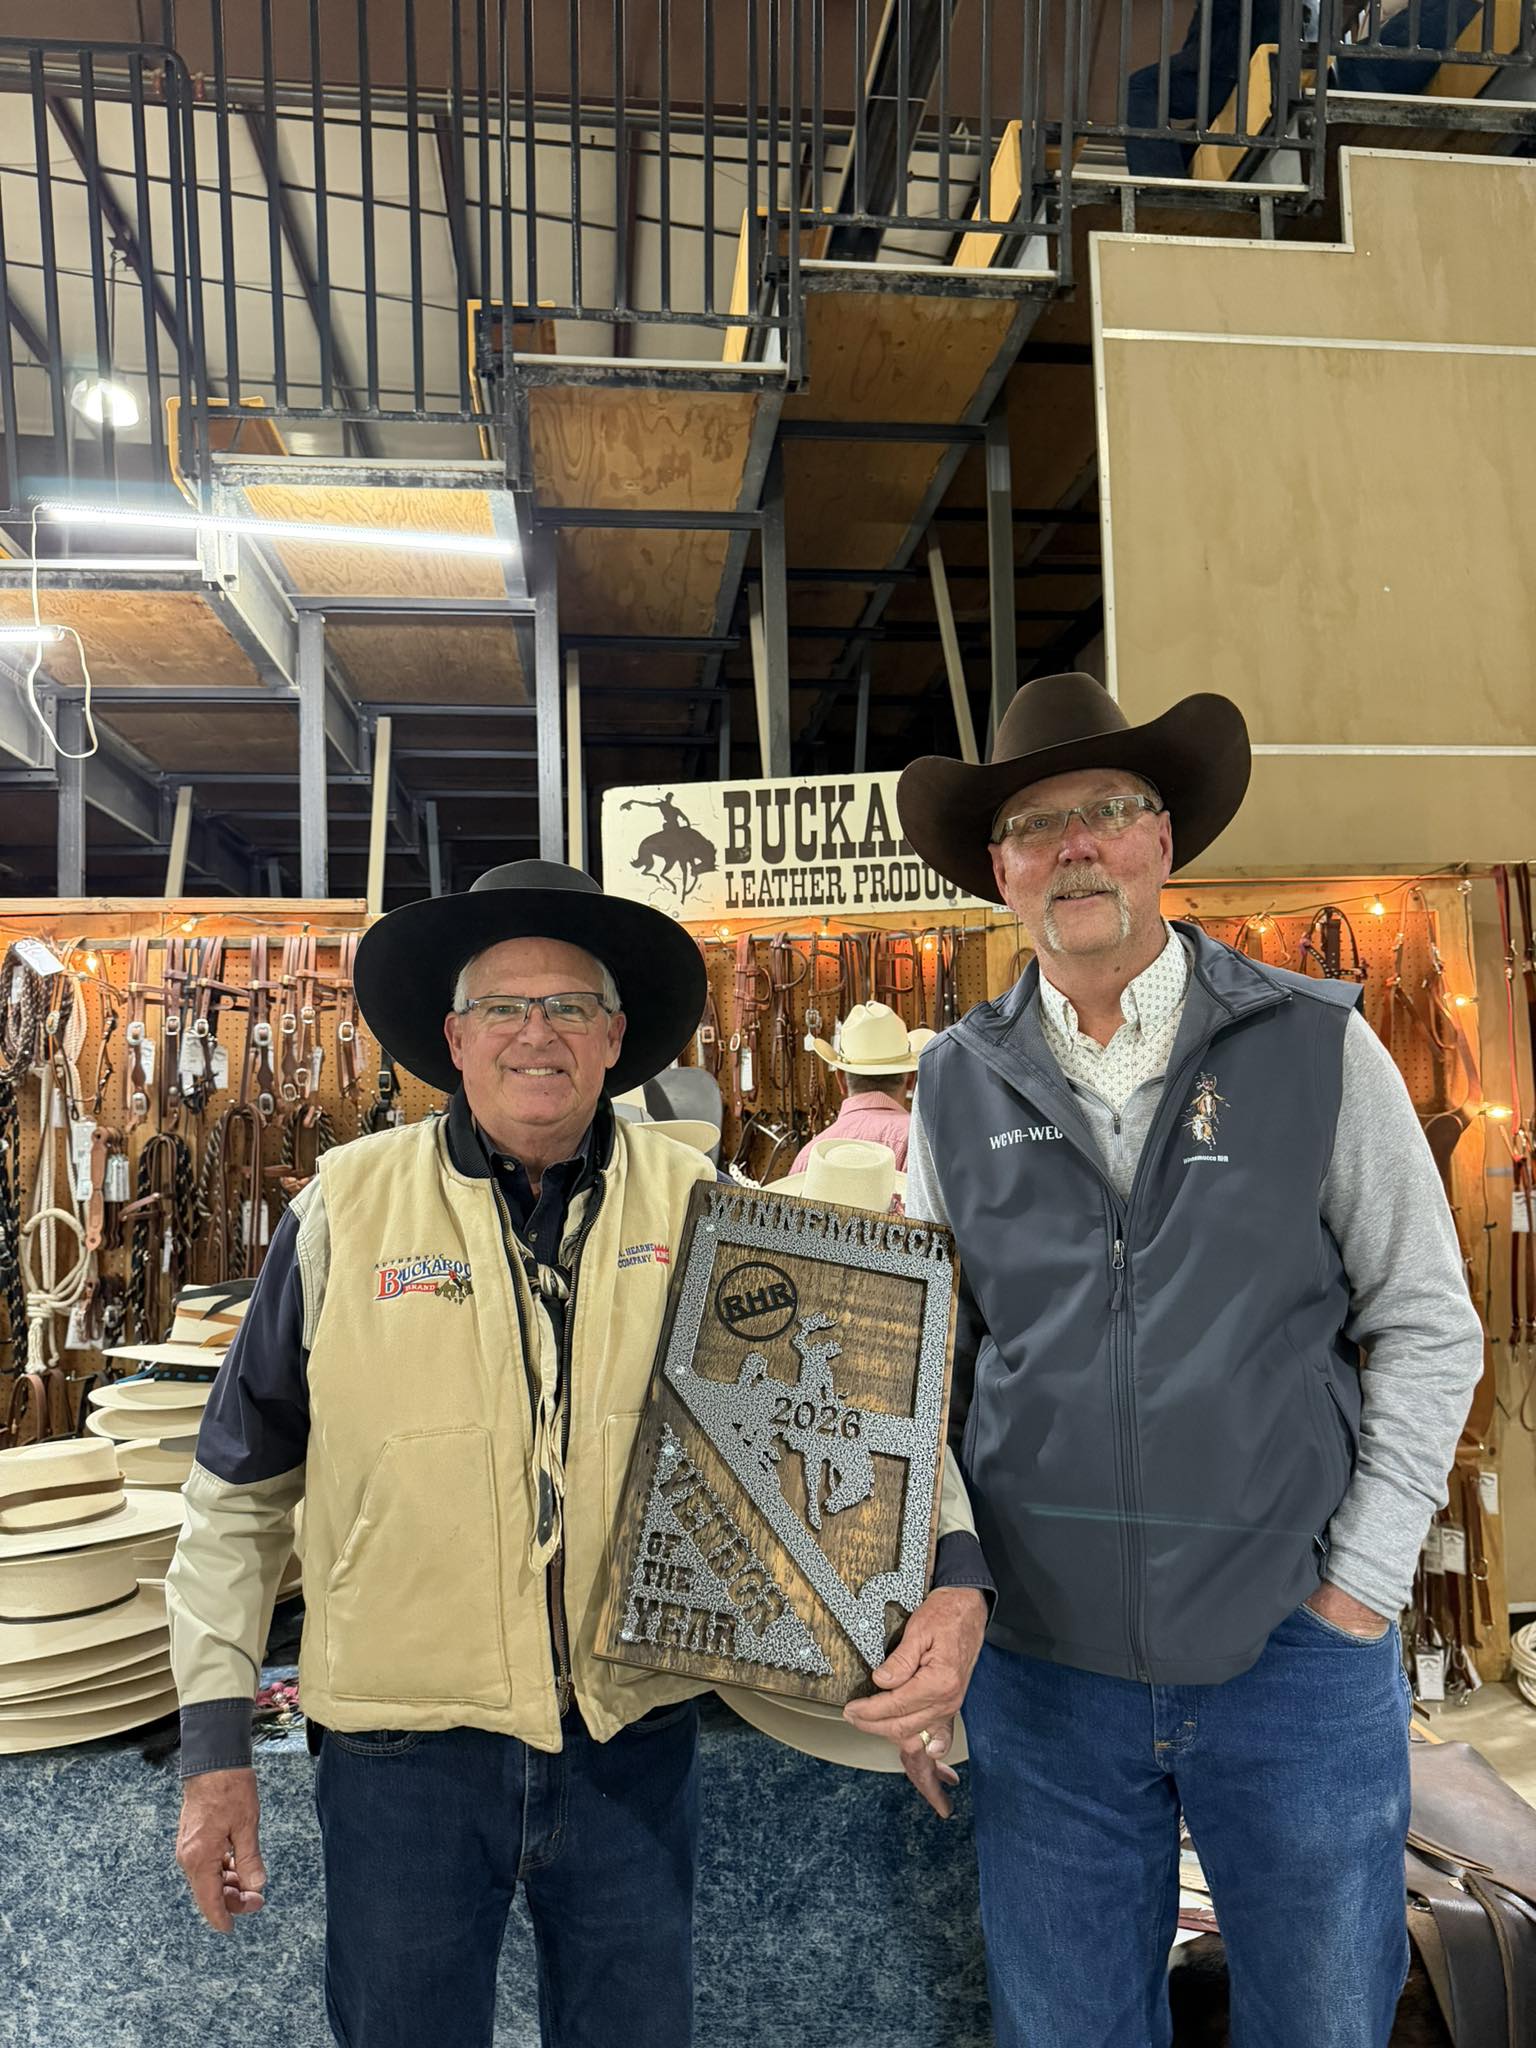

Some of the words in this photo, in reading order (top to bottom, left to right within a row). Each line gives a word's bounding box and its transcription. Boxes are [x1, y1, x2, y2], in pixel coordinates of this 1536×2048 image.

[723, 783, 916, 865] BUCKA
[725, 866, 847, 908] LEATHER
[854, 861, 972, 903] PRODU
[708, 1190, 951, 1262] WINNEMUCCA
[374, 1253, 445, 1269] AUTHENTIC
[617, 1254, 652, 1268] COMPANY
[405, 1283, 436, 1292] BRAND
[769, 1397, 861, 1440] 2026
[647, 1531, 683, 1559] OF
[642, 1560, 695, 1594] THE
[632, 1596, 736, 1655] YEAR
